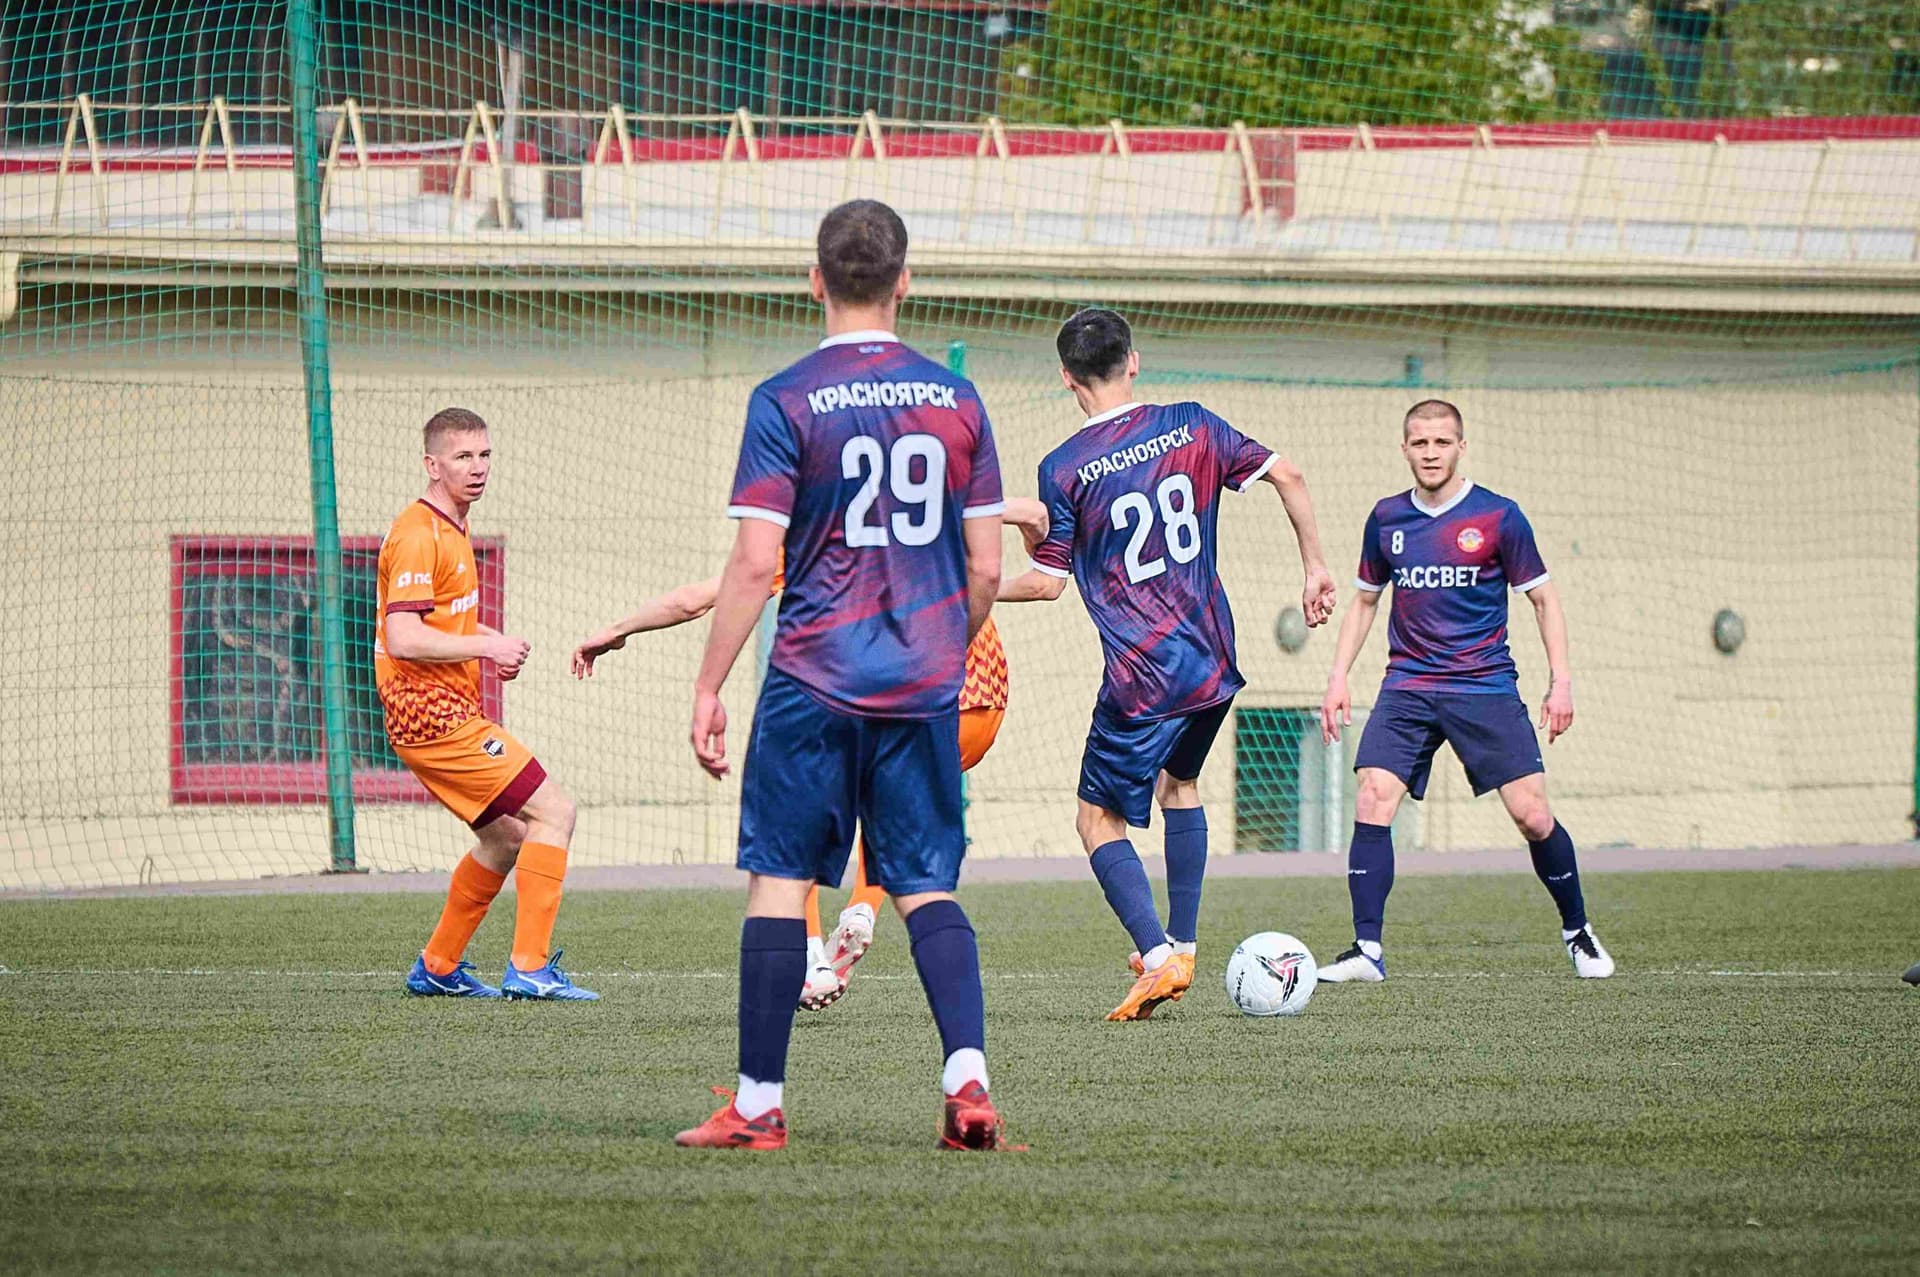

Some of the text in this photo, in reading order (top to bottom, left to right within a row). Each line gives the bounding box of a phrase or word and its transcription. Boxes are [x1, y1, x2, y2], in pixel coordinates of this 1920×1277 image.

[808, 381, 958, 415] КРАСНОЯРСК
[1077, 423, 1194, 486] КРАСНОЯРСК
[841, 433, 946, 547] 29
[1110, 473, 1201, 584] 28
[1391, 530, 1404, 555] 8
